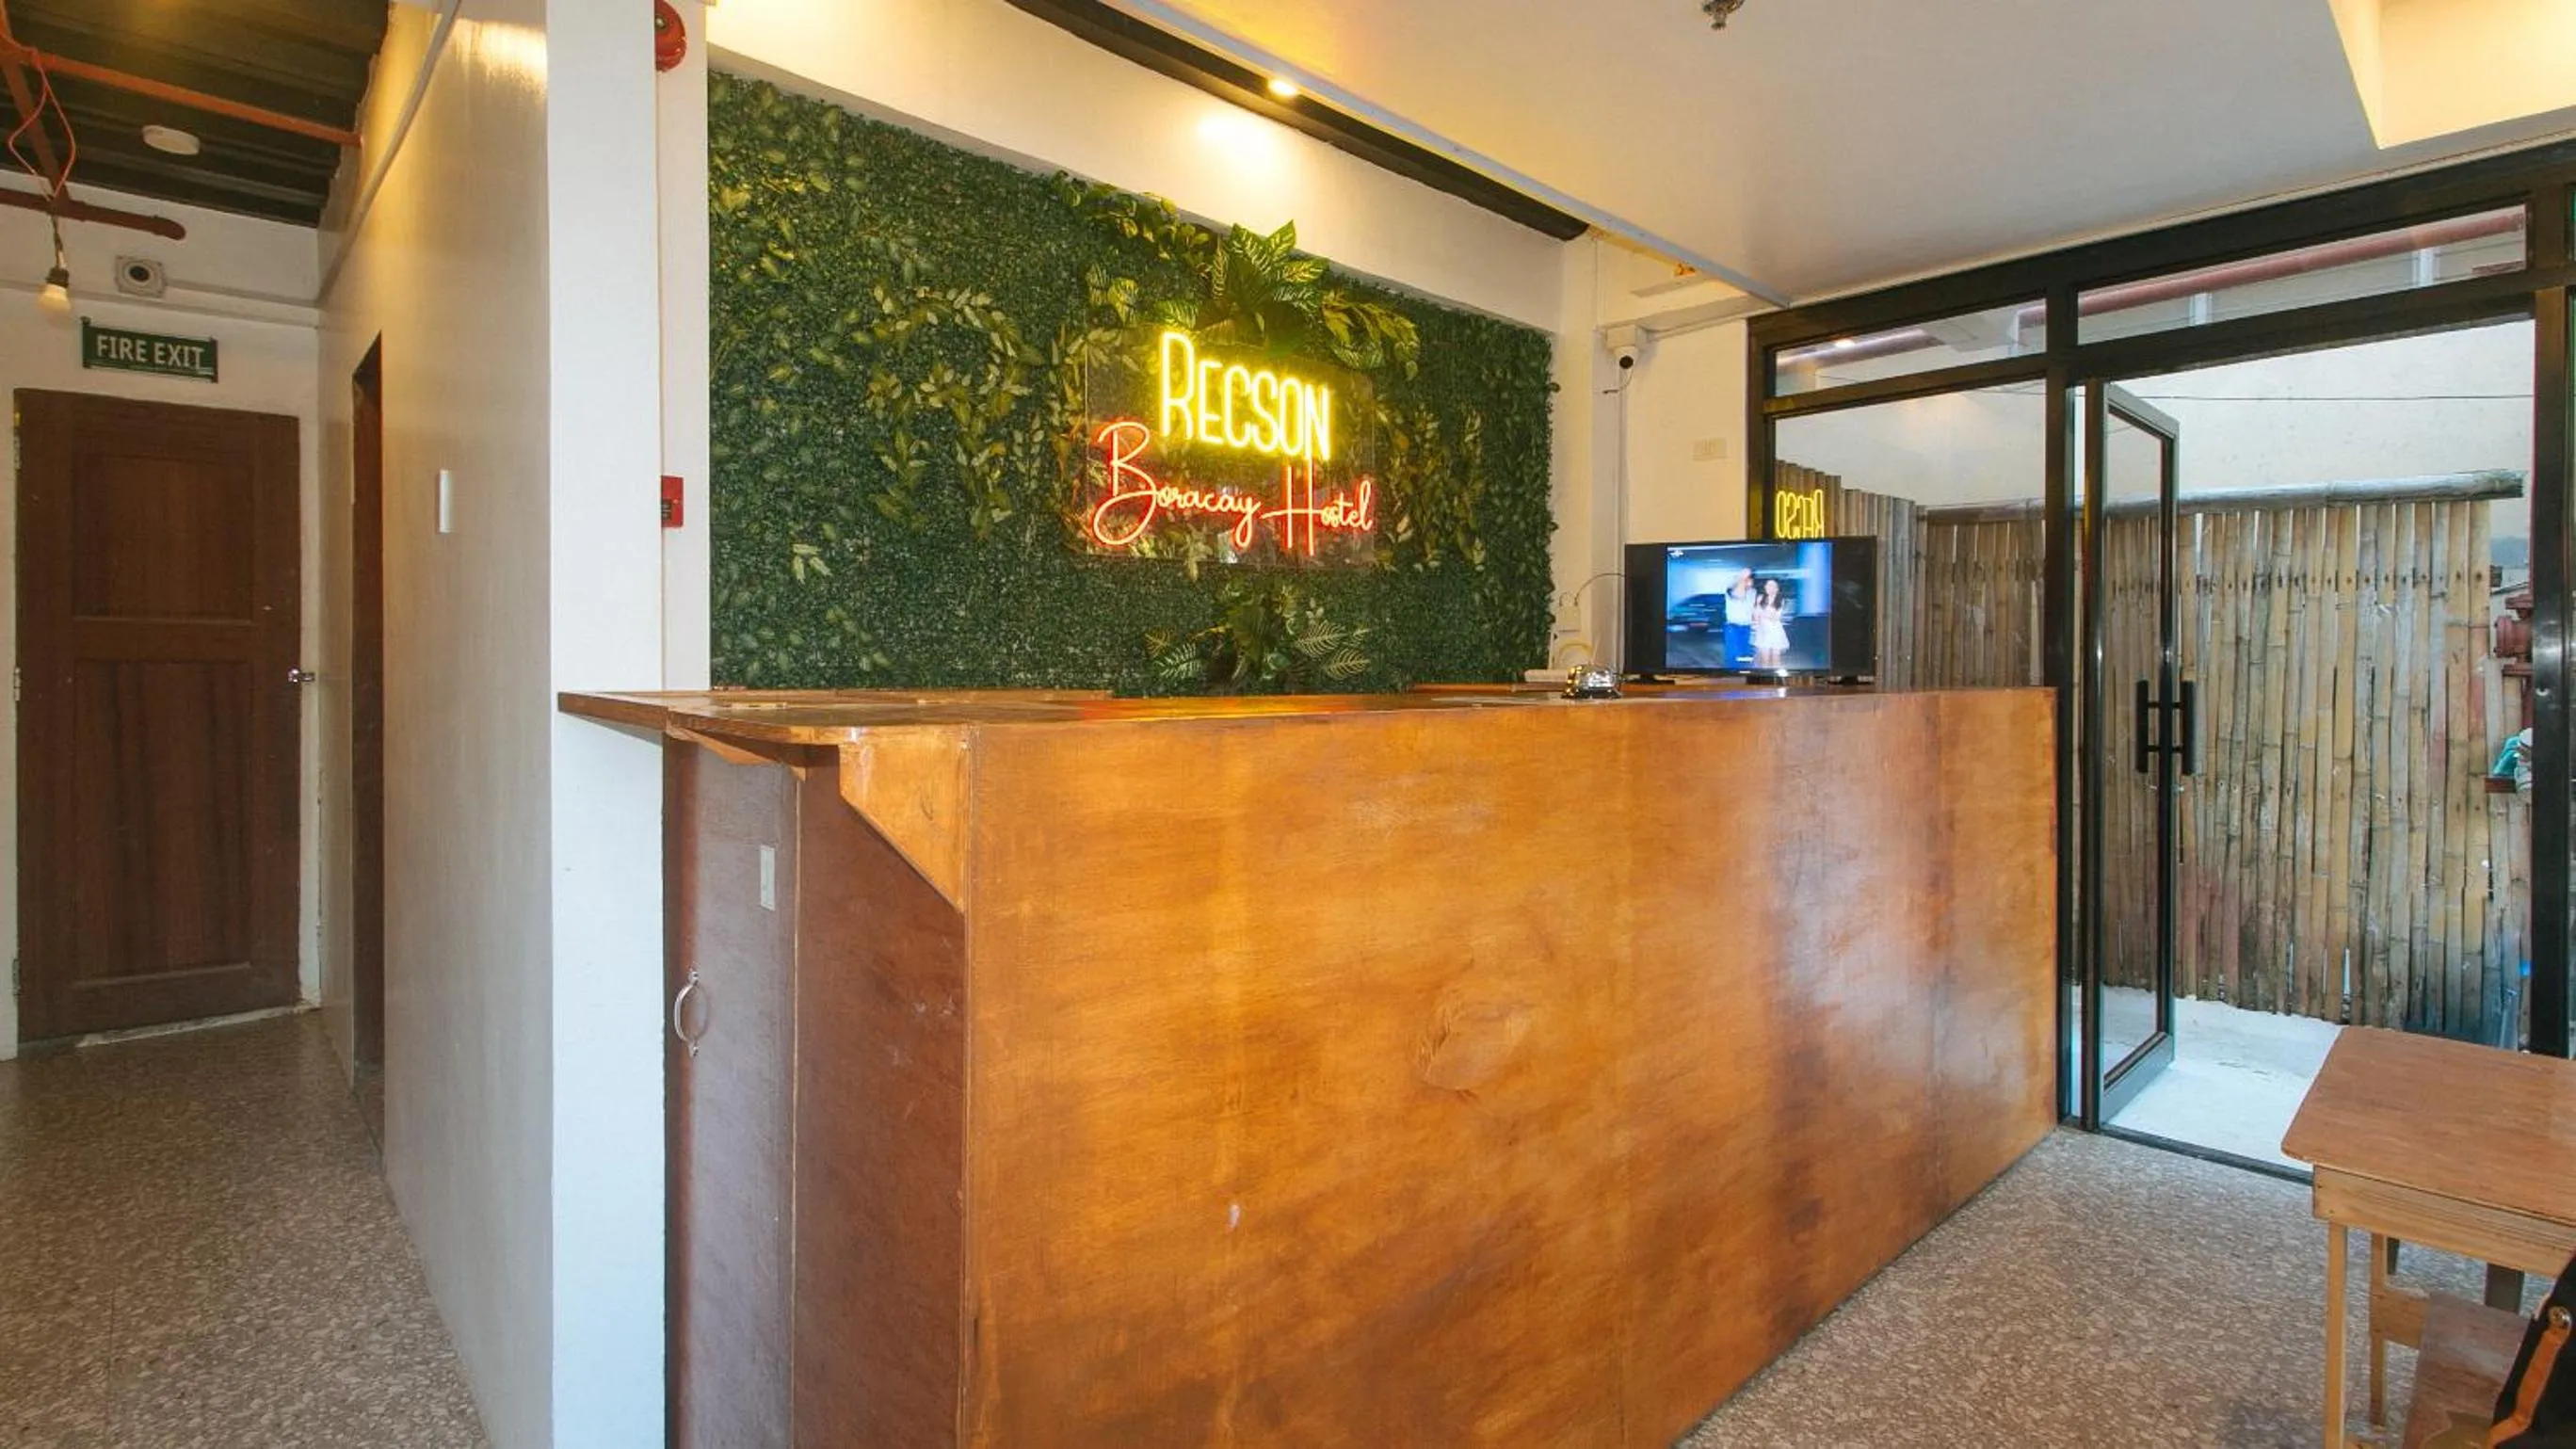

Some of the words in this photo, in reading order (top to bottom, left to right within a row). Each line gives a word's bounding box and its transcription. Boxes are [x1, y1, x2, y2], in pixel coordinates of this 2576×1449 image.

[97, 334, 149, 362] FIRE
[153, 342, 205, 369] EXIT
[1161, 331, 1331, 461] RECSON
[1093, 421, 1262, 548] Boracay
[1261, 458, 1374, 556] Hostel
